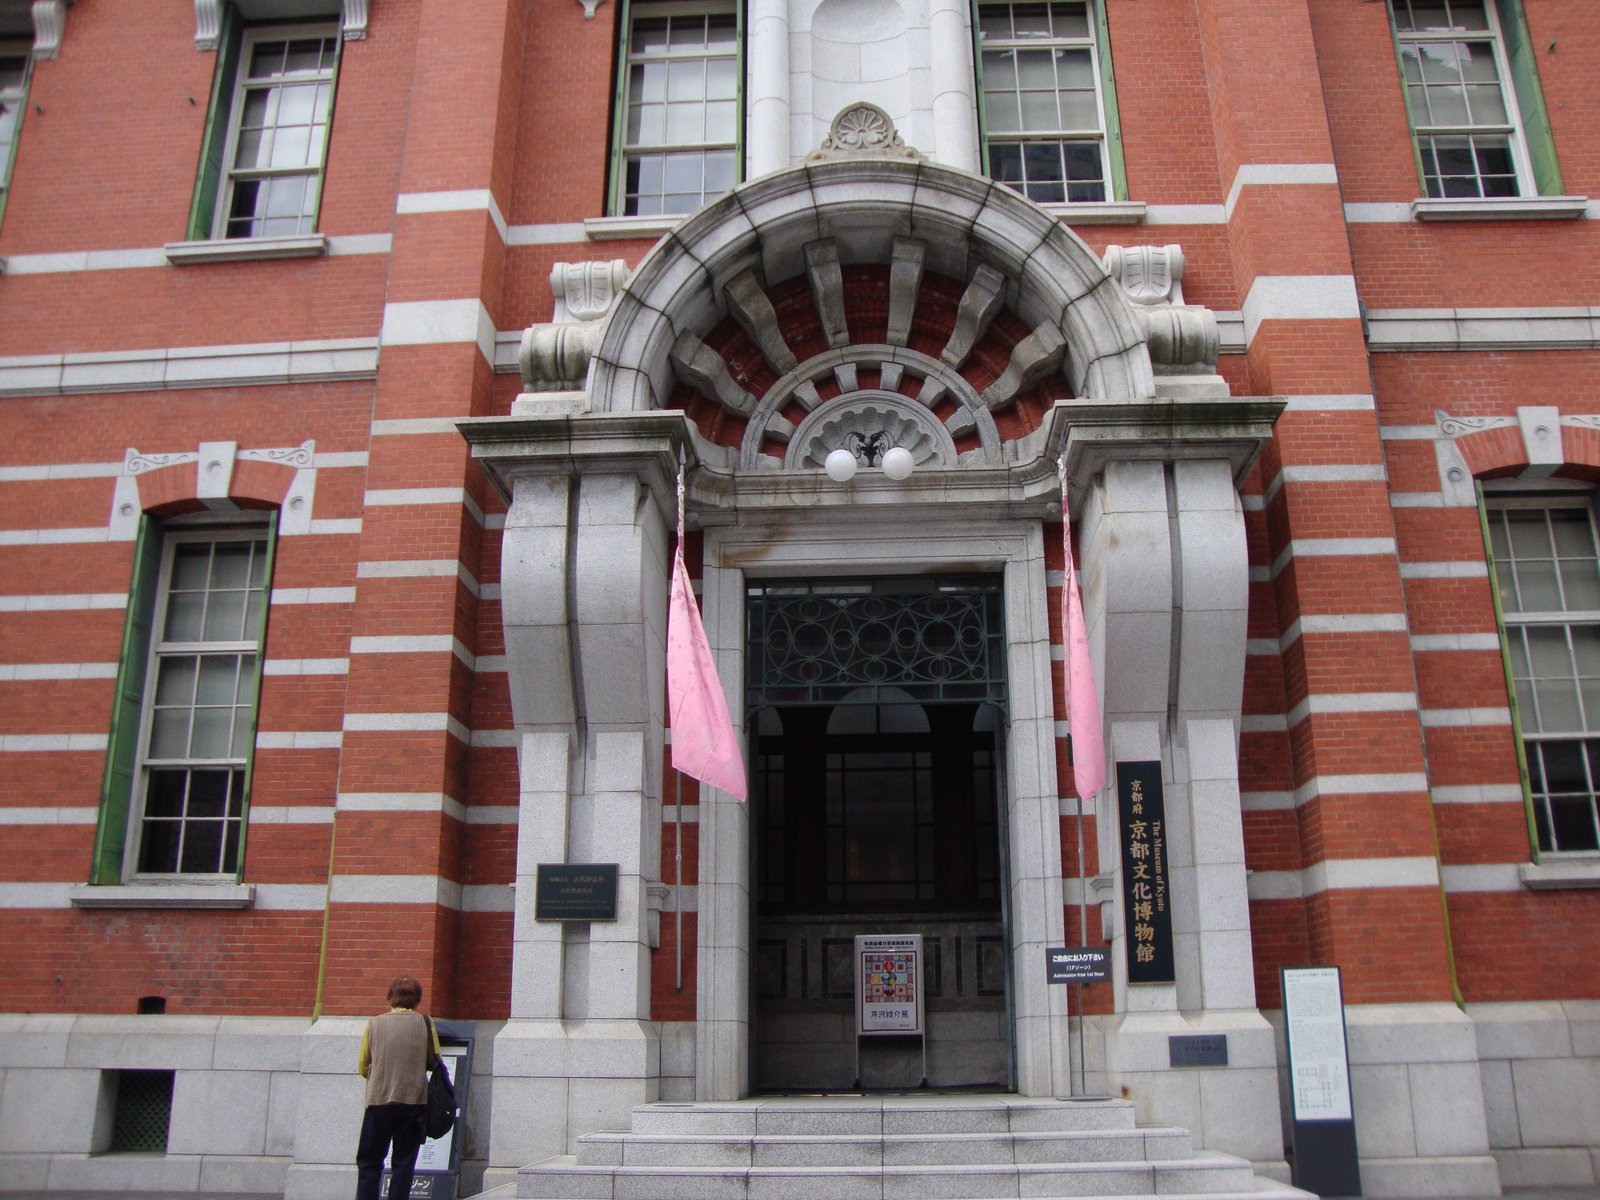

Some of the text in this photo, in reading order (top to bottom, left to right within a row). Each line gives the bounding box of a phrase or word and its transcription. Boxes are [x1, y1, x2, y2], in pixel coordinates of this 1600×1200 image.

[1129, 779, 1156, 963] 京都府 京都文化博物館
[1152, 820, 1165, 912] The Museum of Kyoto
[1052, 953, 1105, 963] ご自由にお入り下さい
